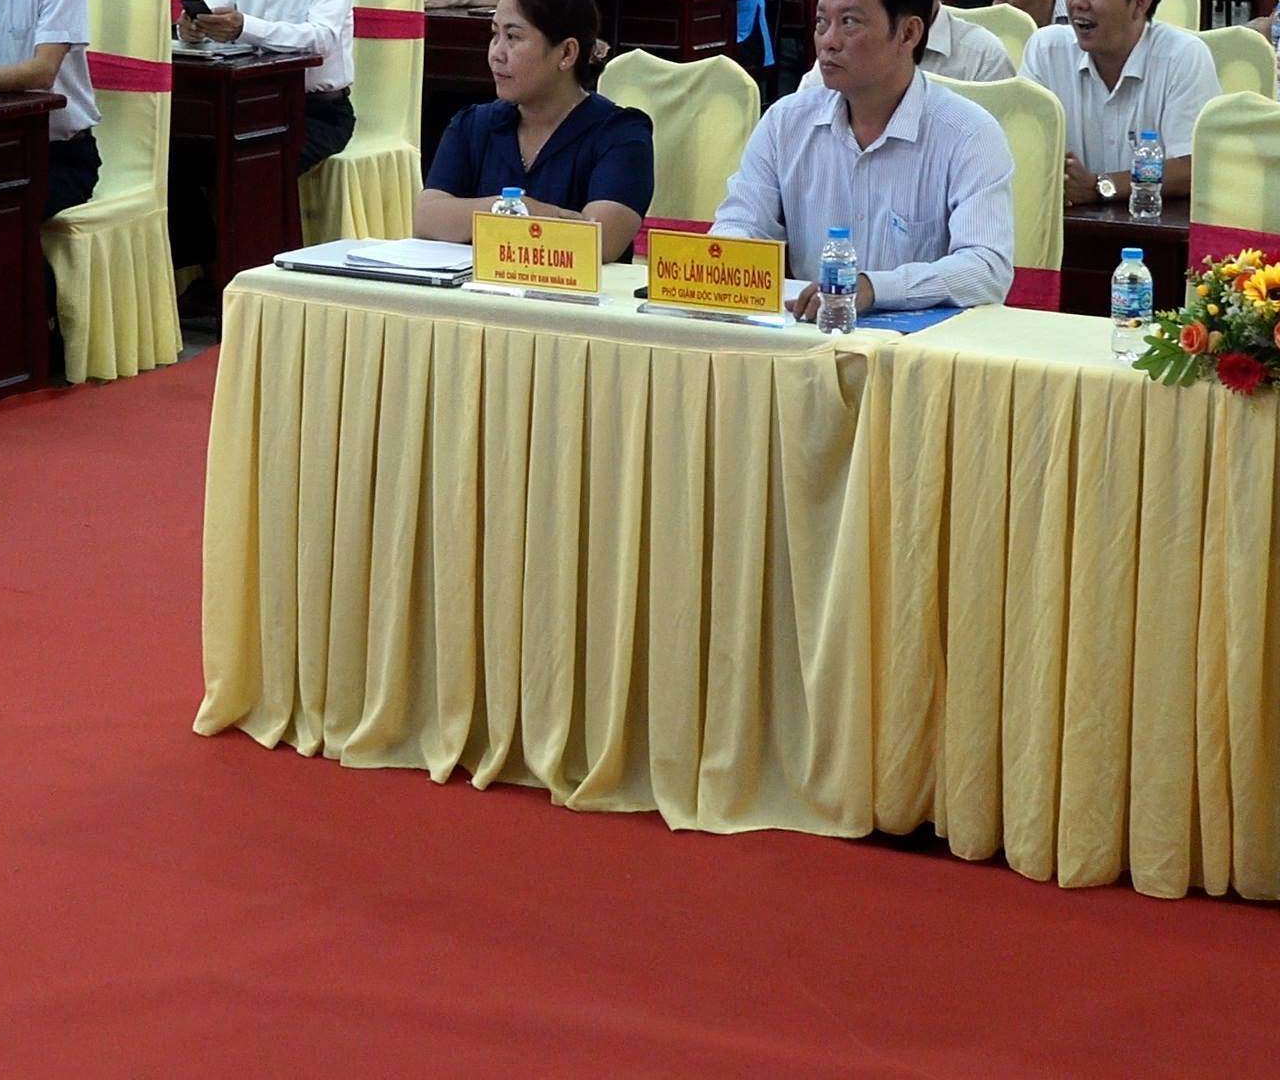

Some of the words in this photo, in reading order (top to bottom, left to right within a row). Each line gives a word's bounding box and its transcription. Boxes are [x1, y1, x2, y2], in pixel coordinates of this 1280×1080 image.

[518, 246, 530, 268] TẠ
[533, 245, 545, 266] BÉ
[548, 249, 573, 269] LOAN
[706, 263, 741, 286] HOÀNG
[713, 292, 732, 303] VNPT
